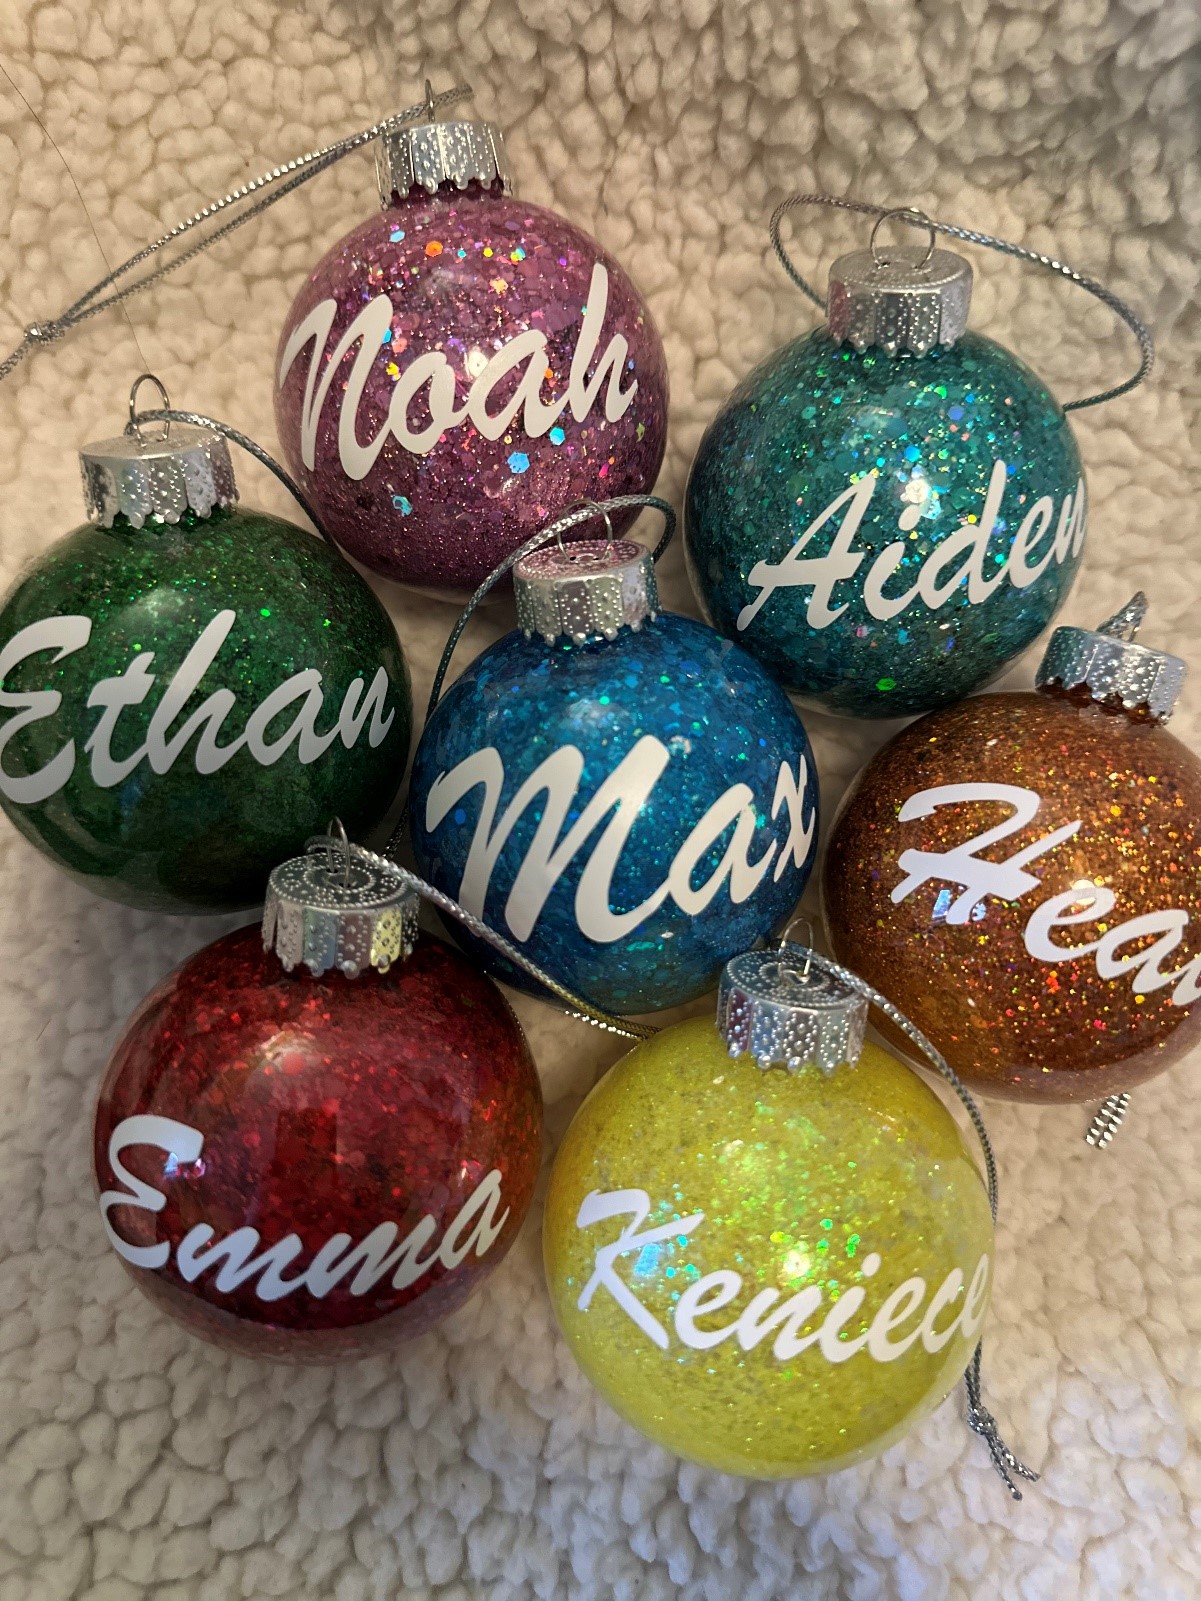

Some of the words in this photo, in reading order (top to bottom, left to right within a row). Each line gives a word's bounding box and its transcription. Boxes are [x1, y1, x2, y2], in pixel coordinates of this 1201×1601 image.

[280, 263, 638, 481] Noah
[736, 460, 1086, 631] Aiden
[0, 609, 395, 804] Ethan
[425, 734, 816, 945] Max
[100, 1114, 510, 1301] Emma
